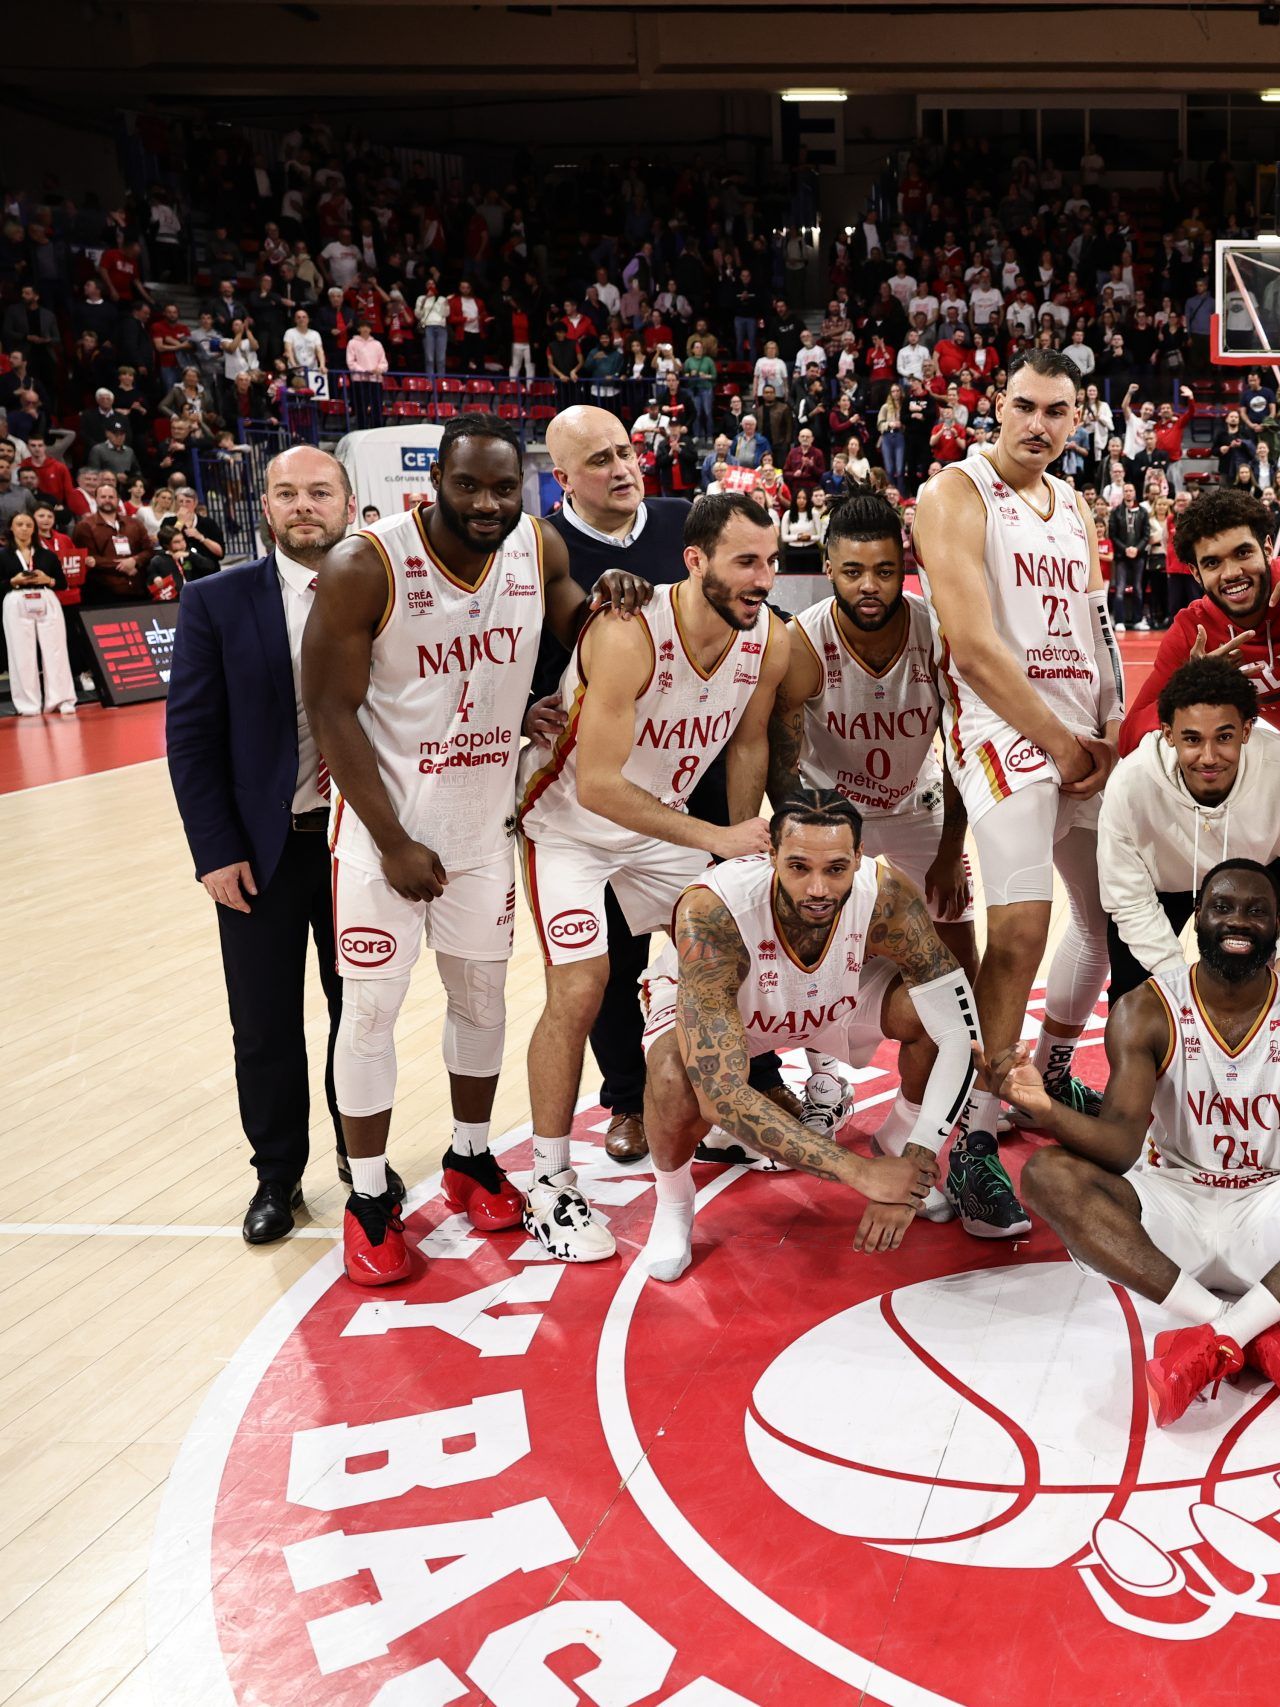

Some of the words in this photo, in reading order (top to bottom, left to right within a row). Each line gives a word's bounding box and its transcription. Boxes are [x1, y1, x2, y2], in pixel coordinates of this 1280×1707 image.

[314, 376, 326, 396] 2
[405, 570, 428, 578] errea
[407, 588, 433, 600] CRÉA
[408, 600, 434, 609] STONE
[1042, 594, 1073, 638] 23
[416, 627, 523, 678] NANCY
[827, 668, 842, 678] RÉA
[456, 681, 474, 722] 4
[636, 707, 737, 750] NANCY
[827, 706, 933, 741] NANCY
[672, 754, 700, 794] 8
[866, 748, 891, 781] 0
[550, 916, 597, 940] cora
[341, 937, 392, 954] cora
[1184, 1035, 1201, 1046] RÉA
[1185, 1046, 1201, 1054] TONE
[1213, 1134, 1263, 1170] 24
